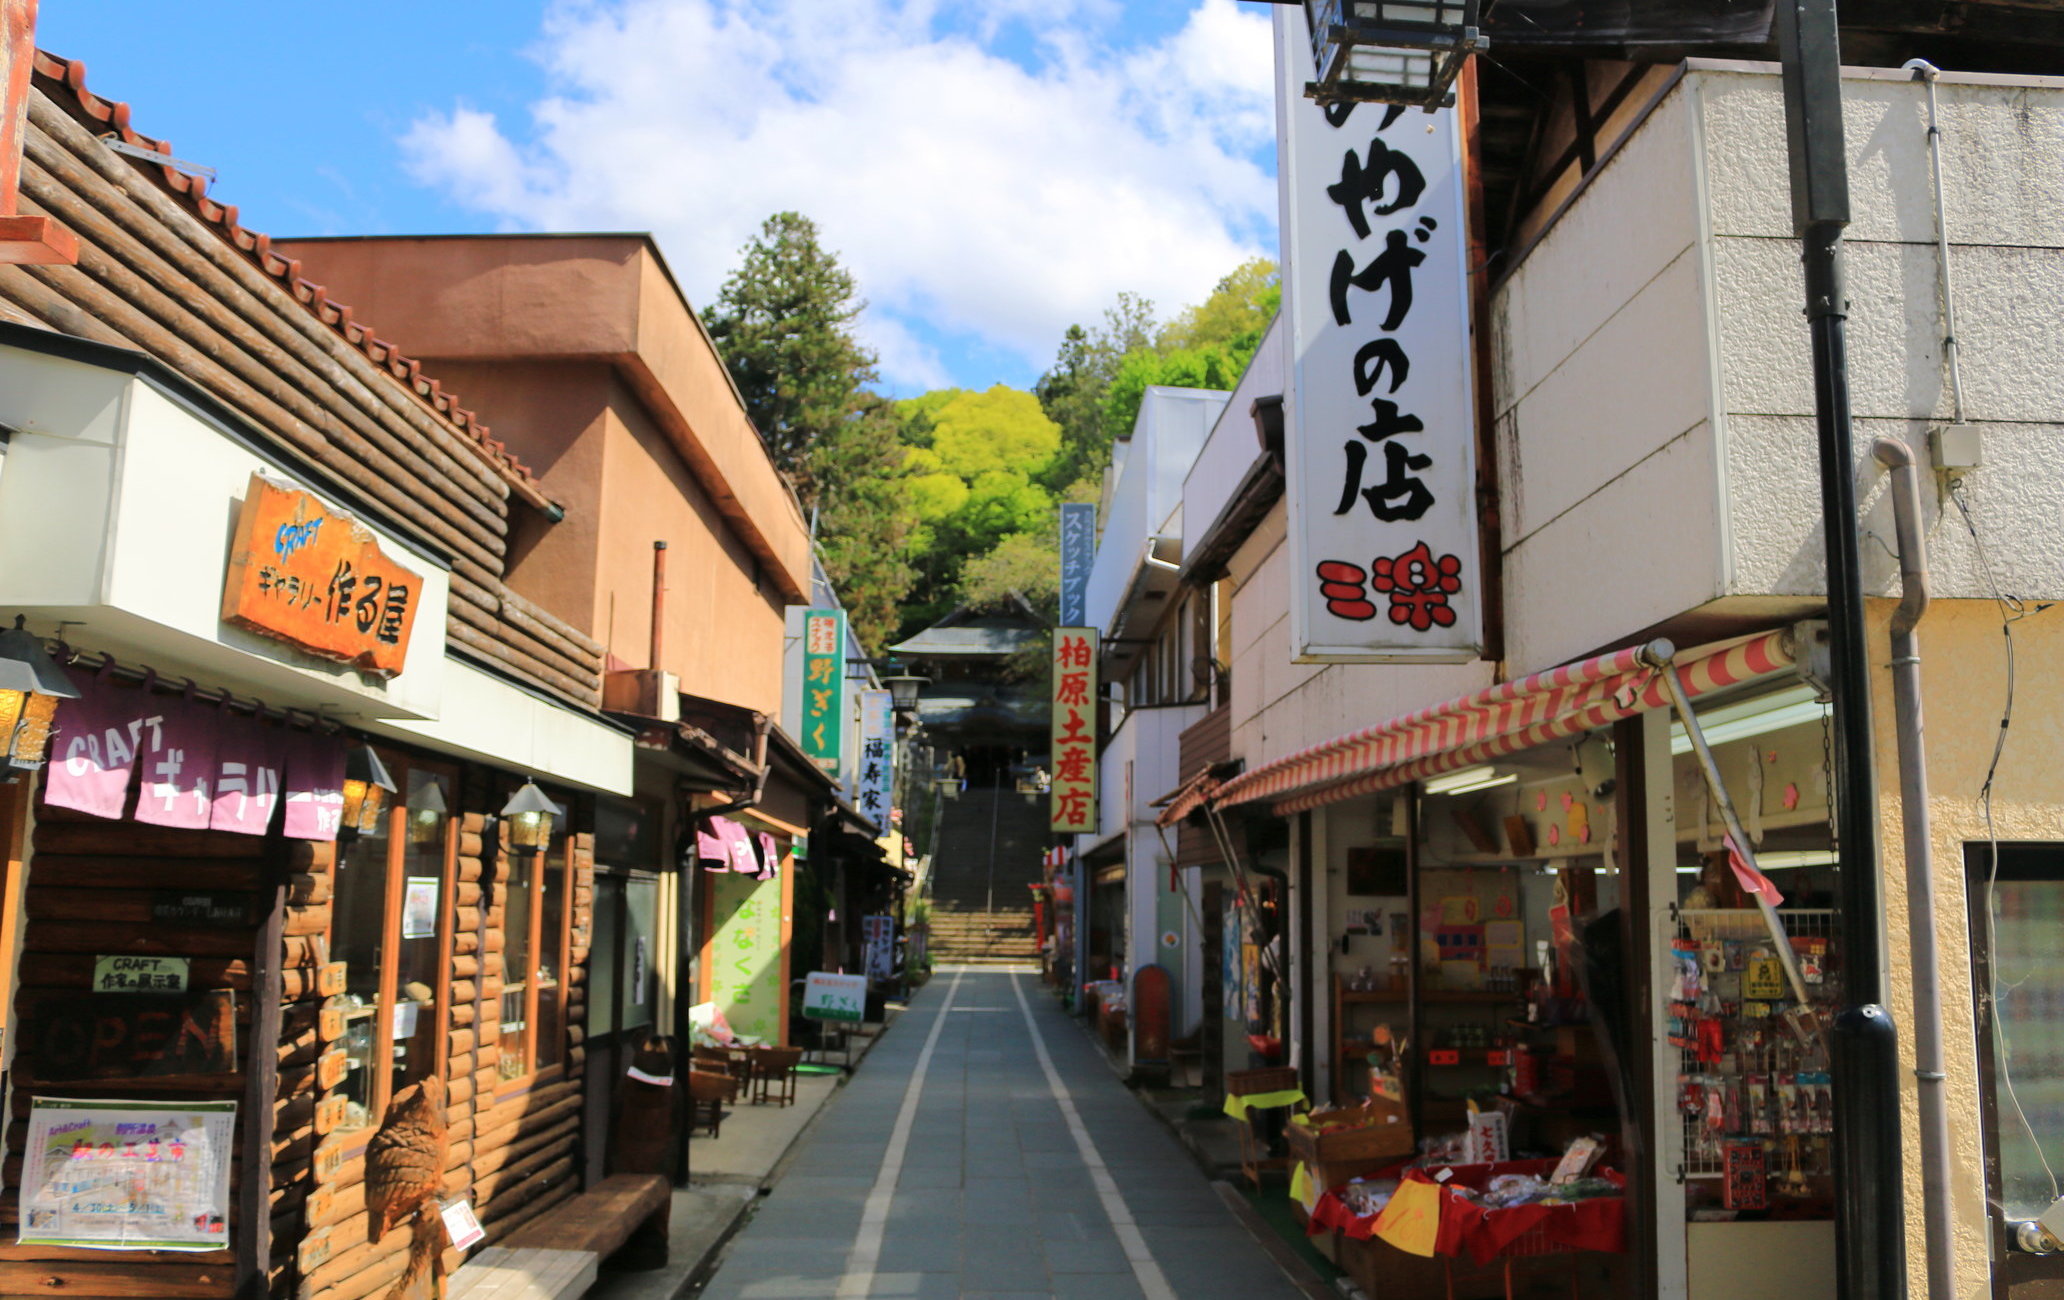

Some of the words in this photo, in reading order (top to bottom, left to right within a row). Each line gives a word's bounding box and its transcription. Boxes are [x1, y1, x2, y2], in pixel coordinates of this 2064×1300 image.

[274, 517, 323, 564] CRAFT
[65, 715, 163, 777] CRAFT
[1053, 636, 1092, 827] 柏原土産店
[862, 736, 884, 811] 福寿家
[113, 958, 162, 971] CRAFT
[46, 1009, 230, 1068] OPEN
